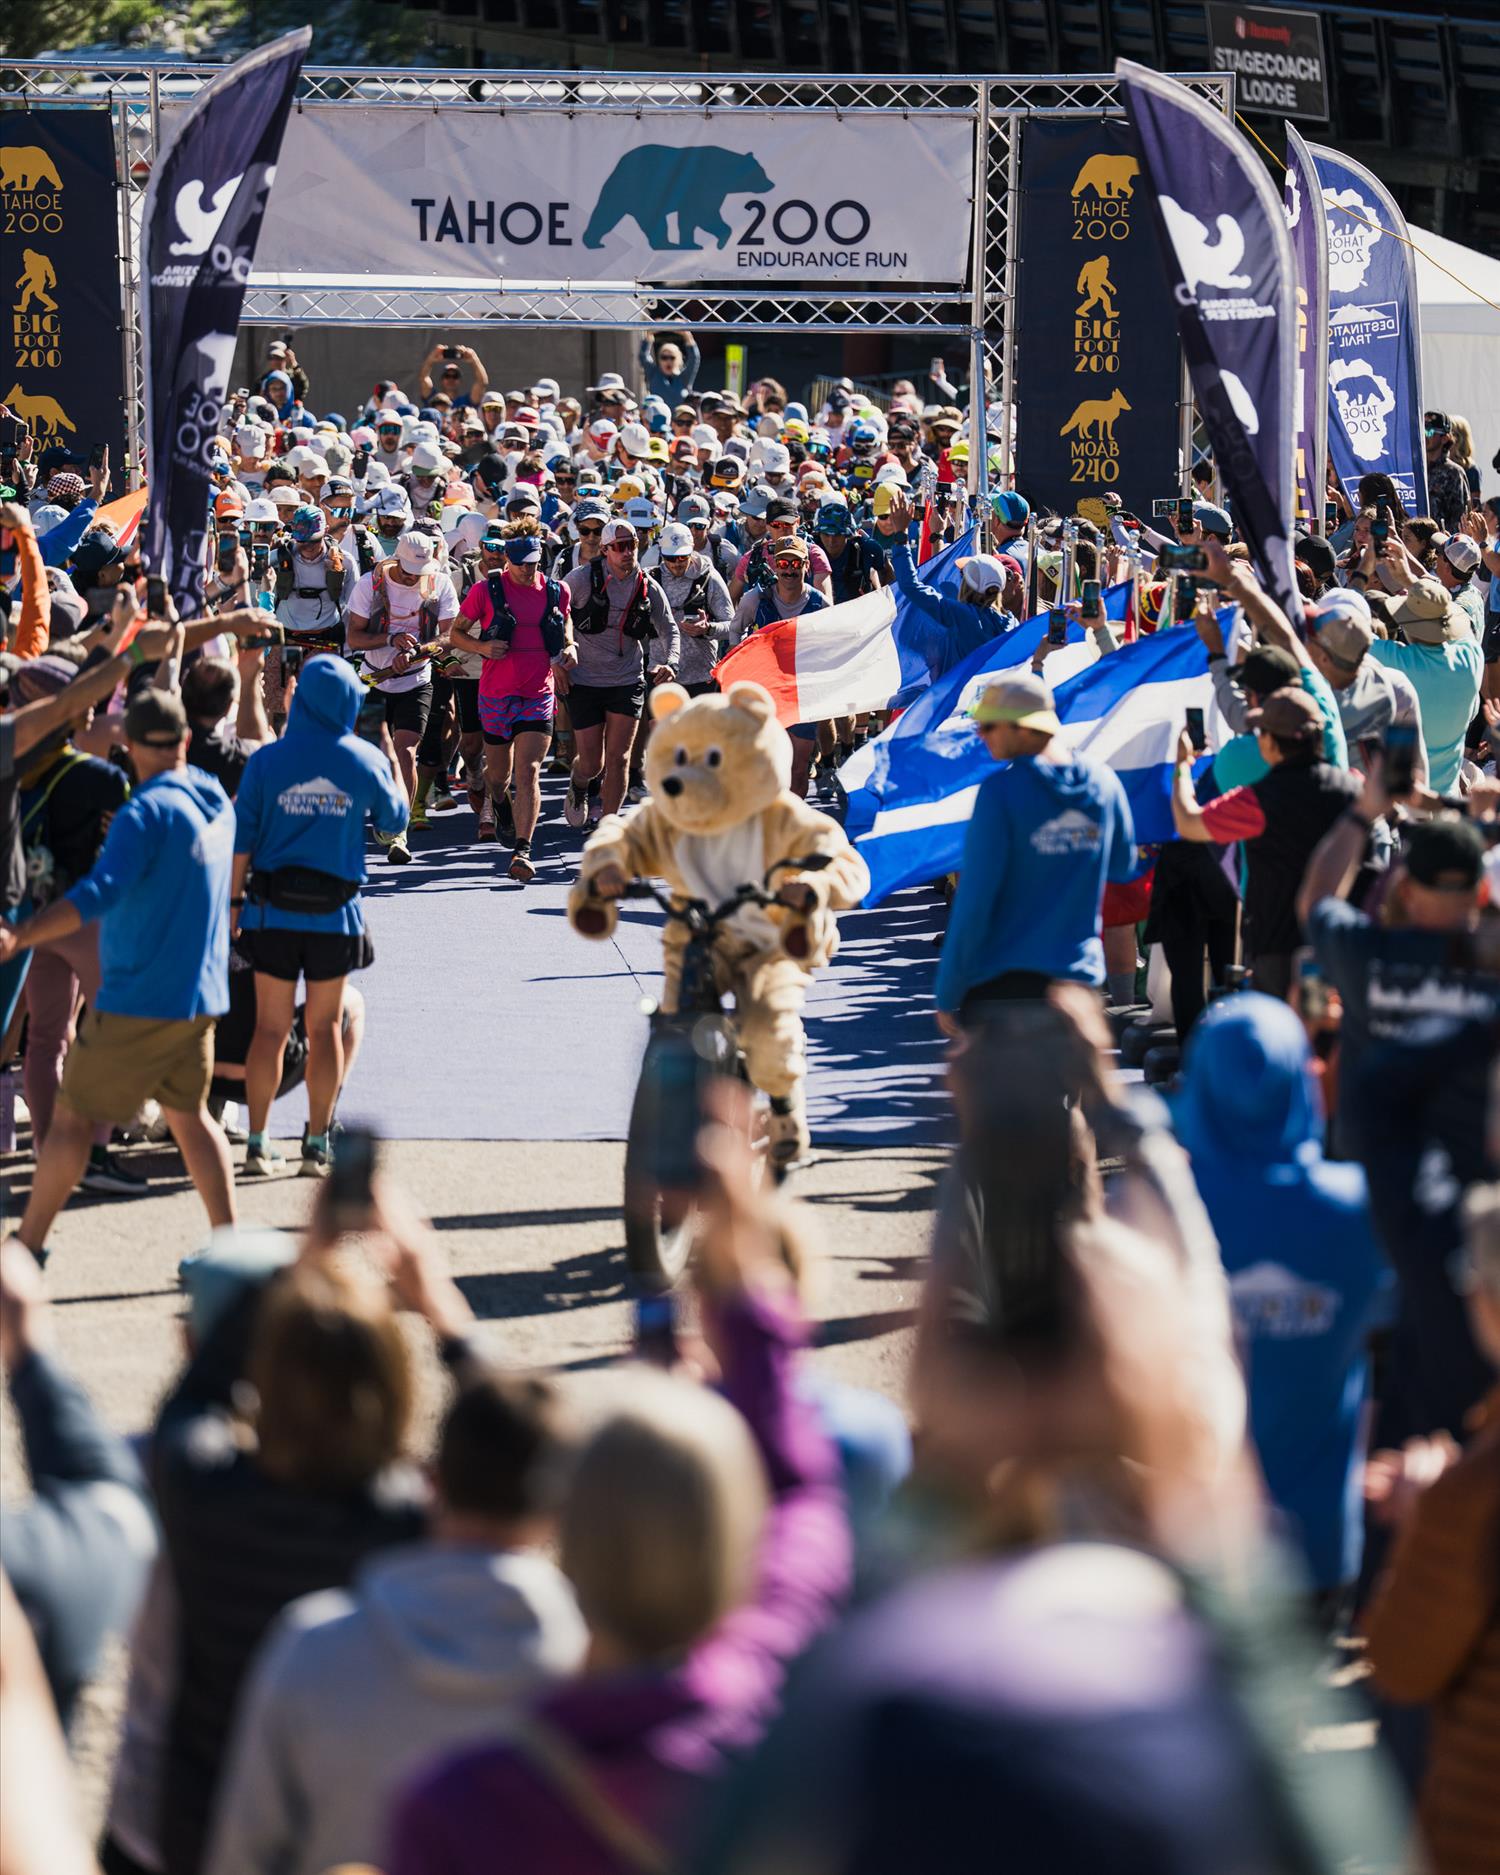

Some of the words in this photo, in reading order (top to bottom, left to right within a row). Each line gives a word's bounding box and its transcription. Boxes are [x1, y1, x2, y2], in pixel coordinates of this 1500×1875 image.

[1214, 46, 1321, 82] STAGECOACH
[1240, 77, 1297, 108] LODGE
[2, 193, 63, 210] TAHOE
[1071, 200, 1130, 217] TAHOE
[4, 212, 64, 233] 200
[411, 195, 573, 246] TAHOE
[737, 199, 871, 246] 200
[1071, 219, 1130, 240] 200
[737, 251, 860, 268] ENDURANCE
[865, 252, 908, 268] RUN
[13, 314, 61, 334] BIG
[1074, 319, 1121, 339] BIG
[13, 334, 61, 348] FOOT
[1074, 339, 1120, 353] FOOT
[15, 349, 62, 368] 200
[1074, 354, 1120, 373] 200
[1071, 440, 1120, 458] MOAB
[1070, 458, 1120, 483] 240
